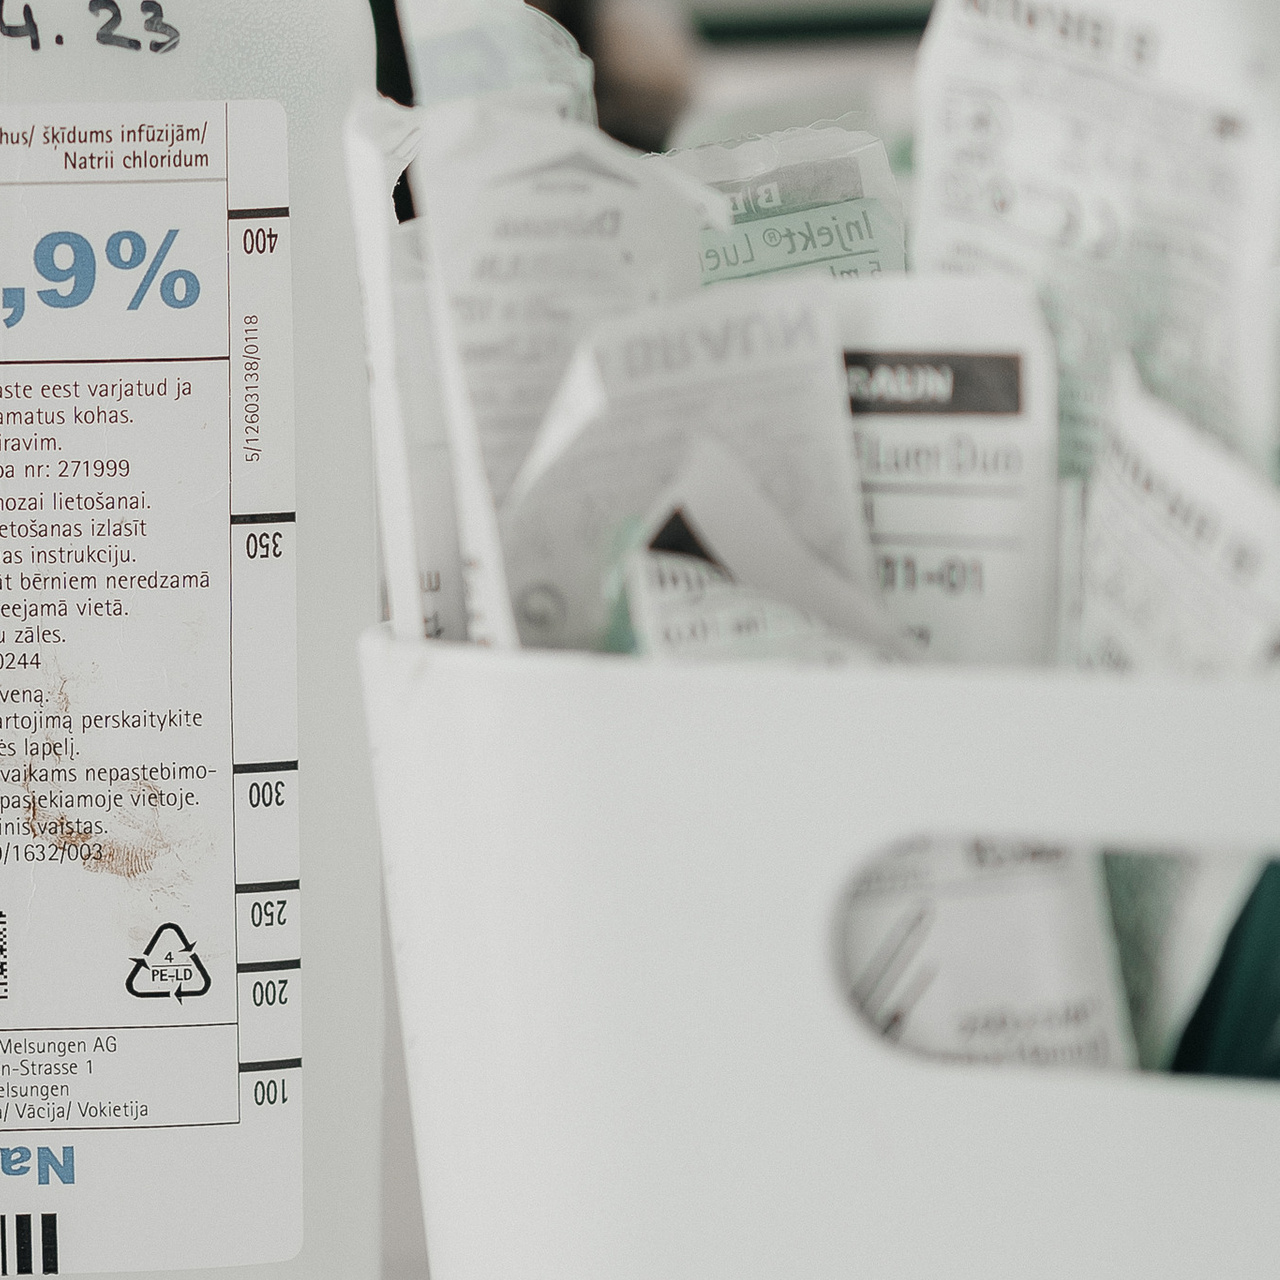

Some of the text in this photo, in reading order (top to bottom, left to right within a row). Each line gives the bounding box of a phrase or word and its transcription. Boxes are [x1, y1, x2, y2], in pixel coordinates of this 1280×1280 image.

[42, 125, 113, 151] šķīdums
[120, 120, 208, 148] infūzijām/
[63, 148, 209, 170] Natrii chloridum
[242, 227, 279, 255] 400
[40, 380, 81, 399] eest
[87, 377, 167, 403] varjatud
[173, 376, 192, 402] ja
[241, 314, 263, 462] 5/12603138/0118
[73, 405, 134, 425] kohas.
[24, 464, 50, 479] nr:
[57, 458, 130, 478] 271999
[53, 490, 151, 511] lietošanai.
[90, 516, 148, 538] izlasīt
[30, 542, 137, 568] instrukciju.
[245, 531, 283, 560] 350
[20, 571, 97, 591] bērniem
[106, 570, 210, 590] neredzamā
[75, 597, 129, 617] vietā.
[14, 624, 66, 646] zāles.
[81, 708, 203, 735] perskaitykite
[24, 735, 82, 762] lapelį.
[0, 763, 79, 784] vaikams
[85, 761, 217, 787] nepastebimo-
[129, 788, 201, 812] vietoje.
[248, 780, 286, 809] 300
[36, 816, 110, 836] vaistas.
[250, 899, 288, 928] 250
[163, 951, 175, 964] 4
[151, 963, 194, 984] PE-LD
[252, 978, 289, 1008] 200
[92, 1035, 117, 1053] AG
[86, 1059, 93, 1075] 1
[253, 1078, 289, 1107] 100
[14, 1097, 73, 1124] Vācija/
[76, 1100, 149, 1121] Vokietija
